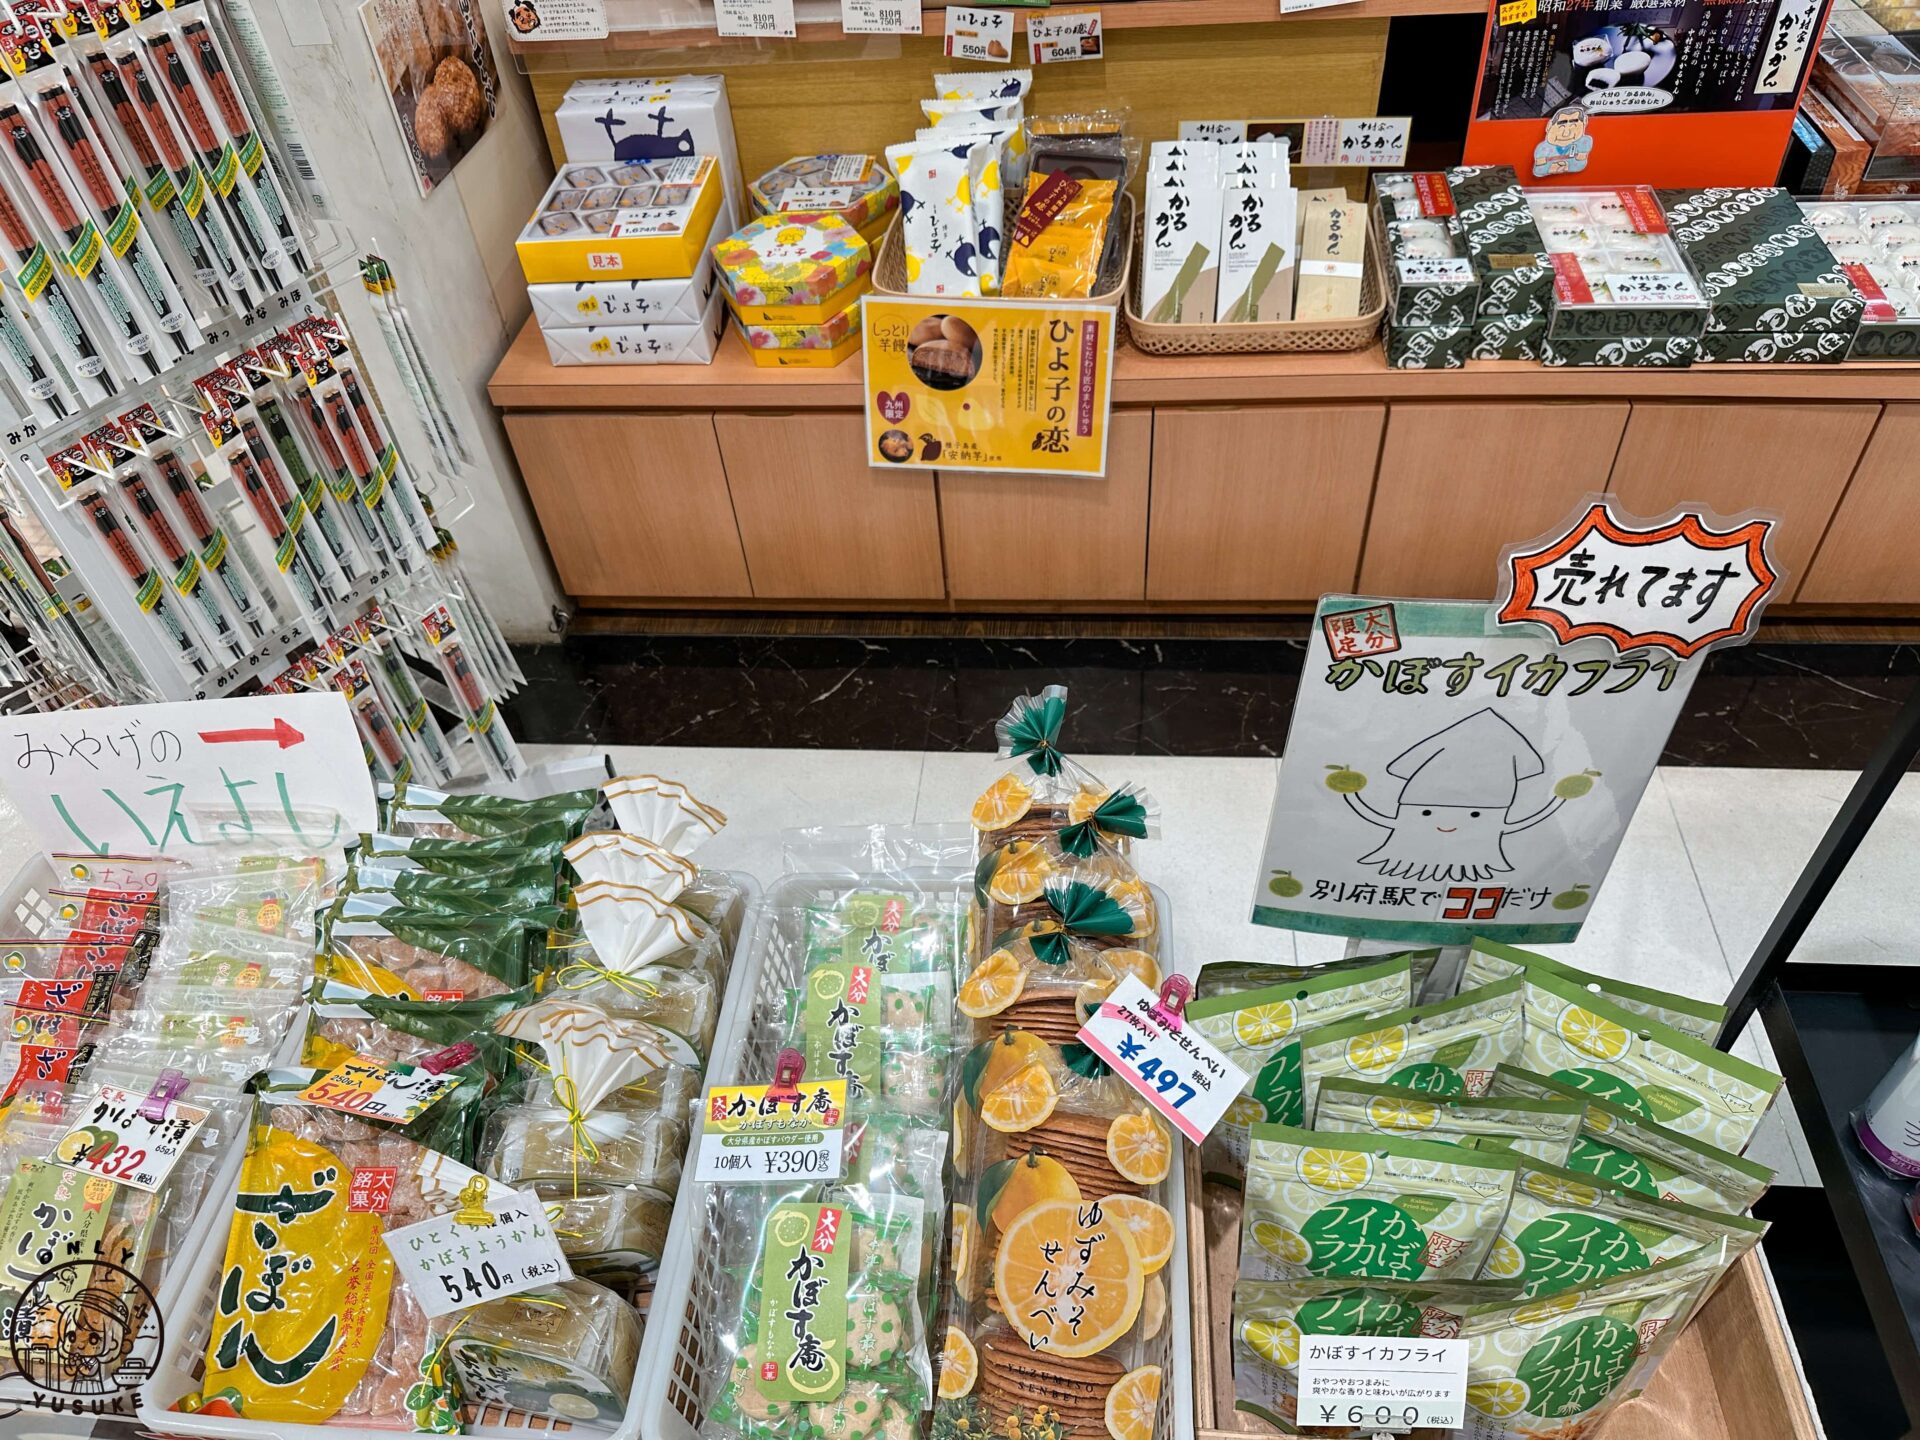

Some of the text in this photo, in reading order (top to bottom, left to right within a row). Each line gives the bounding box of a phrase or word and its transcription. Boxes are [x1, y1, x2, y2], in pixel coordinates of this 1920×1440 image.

[752, 14, 776, 23] 810円
[879, 9, 902, 18] 810円
[879, 17, 903, 27] 750円
[1500, 3, 1529, 14] スタッフ
[753, 22, 777, 31] 750円
[1032, 23, 1088, 38] ひよ子の恋
[962, 44, 987, 56] 550円
[1051, 47, 1077, 58] 604円
[1763, 12, 1800, 88] かるかん
[1342, 134, 1403, 150] かるかん
[1326, 208, 1347, 255] かるかん
[592, 255, 621, 268] 見本
[1616, 281, 1689, 293] かるかん
[872, 321, 910, 338] しっとり
[1043, 318, 1075, 454] ひよ子の恋
[885, 399, 904, 410] 九州
[885, 409, 905, 420] 限定
[6, 423, 38, 446] みか
[1544, 547, 1741, 625] 売れてます
[1331, 617, 1361, 656] 限定
[1363, 611, 1394, 650] 大分
[1324, 651, 1681, 698] かぼすイカフライ
[12, 719, 183, 776] みやげの
[848, 967, 870, 1004] 大分
[1116, 1032, 1213, 1111] ¥497 税込
[307, 1081, 388, 1115] 540円
[712, 1096, 727, 1121] 大分
[726, 1134, 820, 1146] 大分県産かぼすパウダー使用
[738, 1117, 813, 1131] かぼすもなか
[72, 1141, 147, 1181] ¥432
[713, 1154, 753, 1170] 10個入
[764, 1150, 818, 1174] ¥390
[351, 1172, 372, 1208] 銘菓
[372, 1172, 393, 1208] 大分
[418, 1222, 547, 1272] かぼすようかん
[815, 1208, 840, 1252] 大分
[213, 1165, 339, 1387] ざぼん
[441, 1257, 562, 1304] 540円 (税込)
[1066, 1201, 1105, 1337] ゆずみそ
[784, 1245, 829, 1373] かぼす庵
[1029, 1241, 1064, 1351] せんべい
[765, 1298, 779, 1360] かぼすもなか
[1309, 1345, 1448, 1363] かぼすイカフライ
[1560, 1325, 1590, 1388] イカ
[1588, 1319, 1635, 1397] かぼす
[1005, 1360, 1096, 1394] YUZUMISO
[1312, 1377, 1391, 1388] おやつやおつまみに
[1312, 1387, 1451, 1398] 爽やかな香りと味わいが広がります
[1530, 1334, 1561, 1417] フライ
[1016, 1381, 1080, 1406] SENBEI
[1426, 1415, 1456, 1425] (税込)
